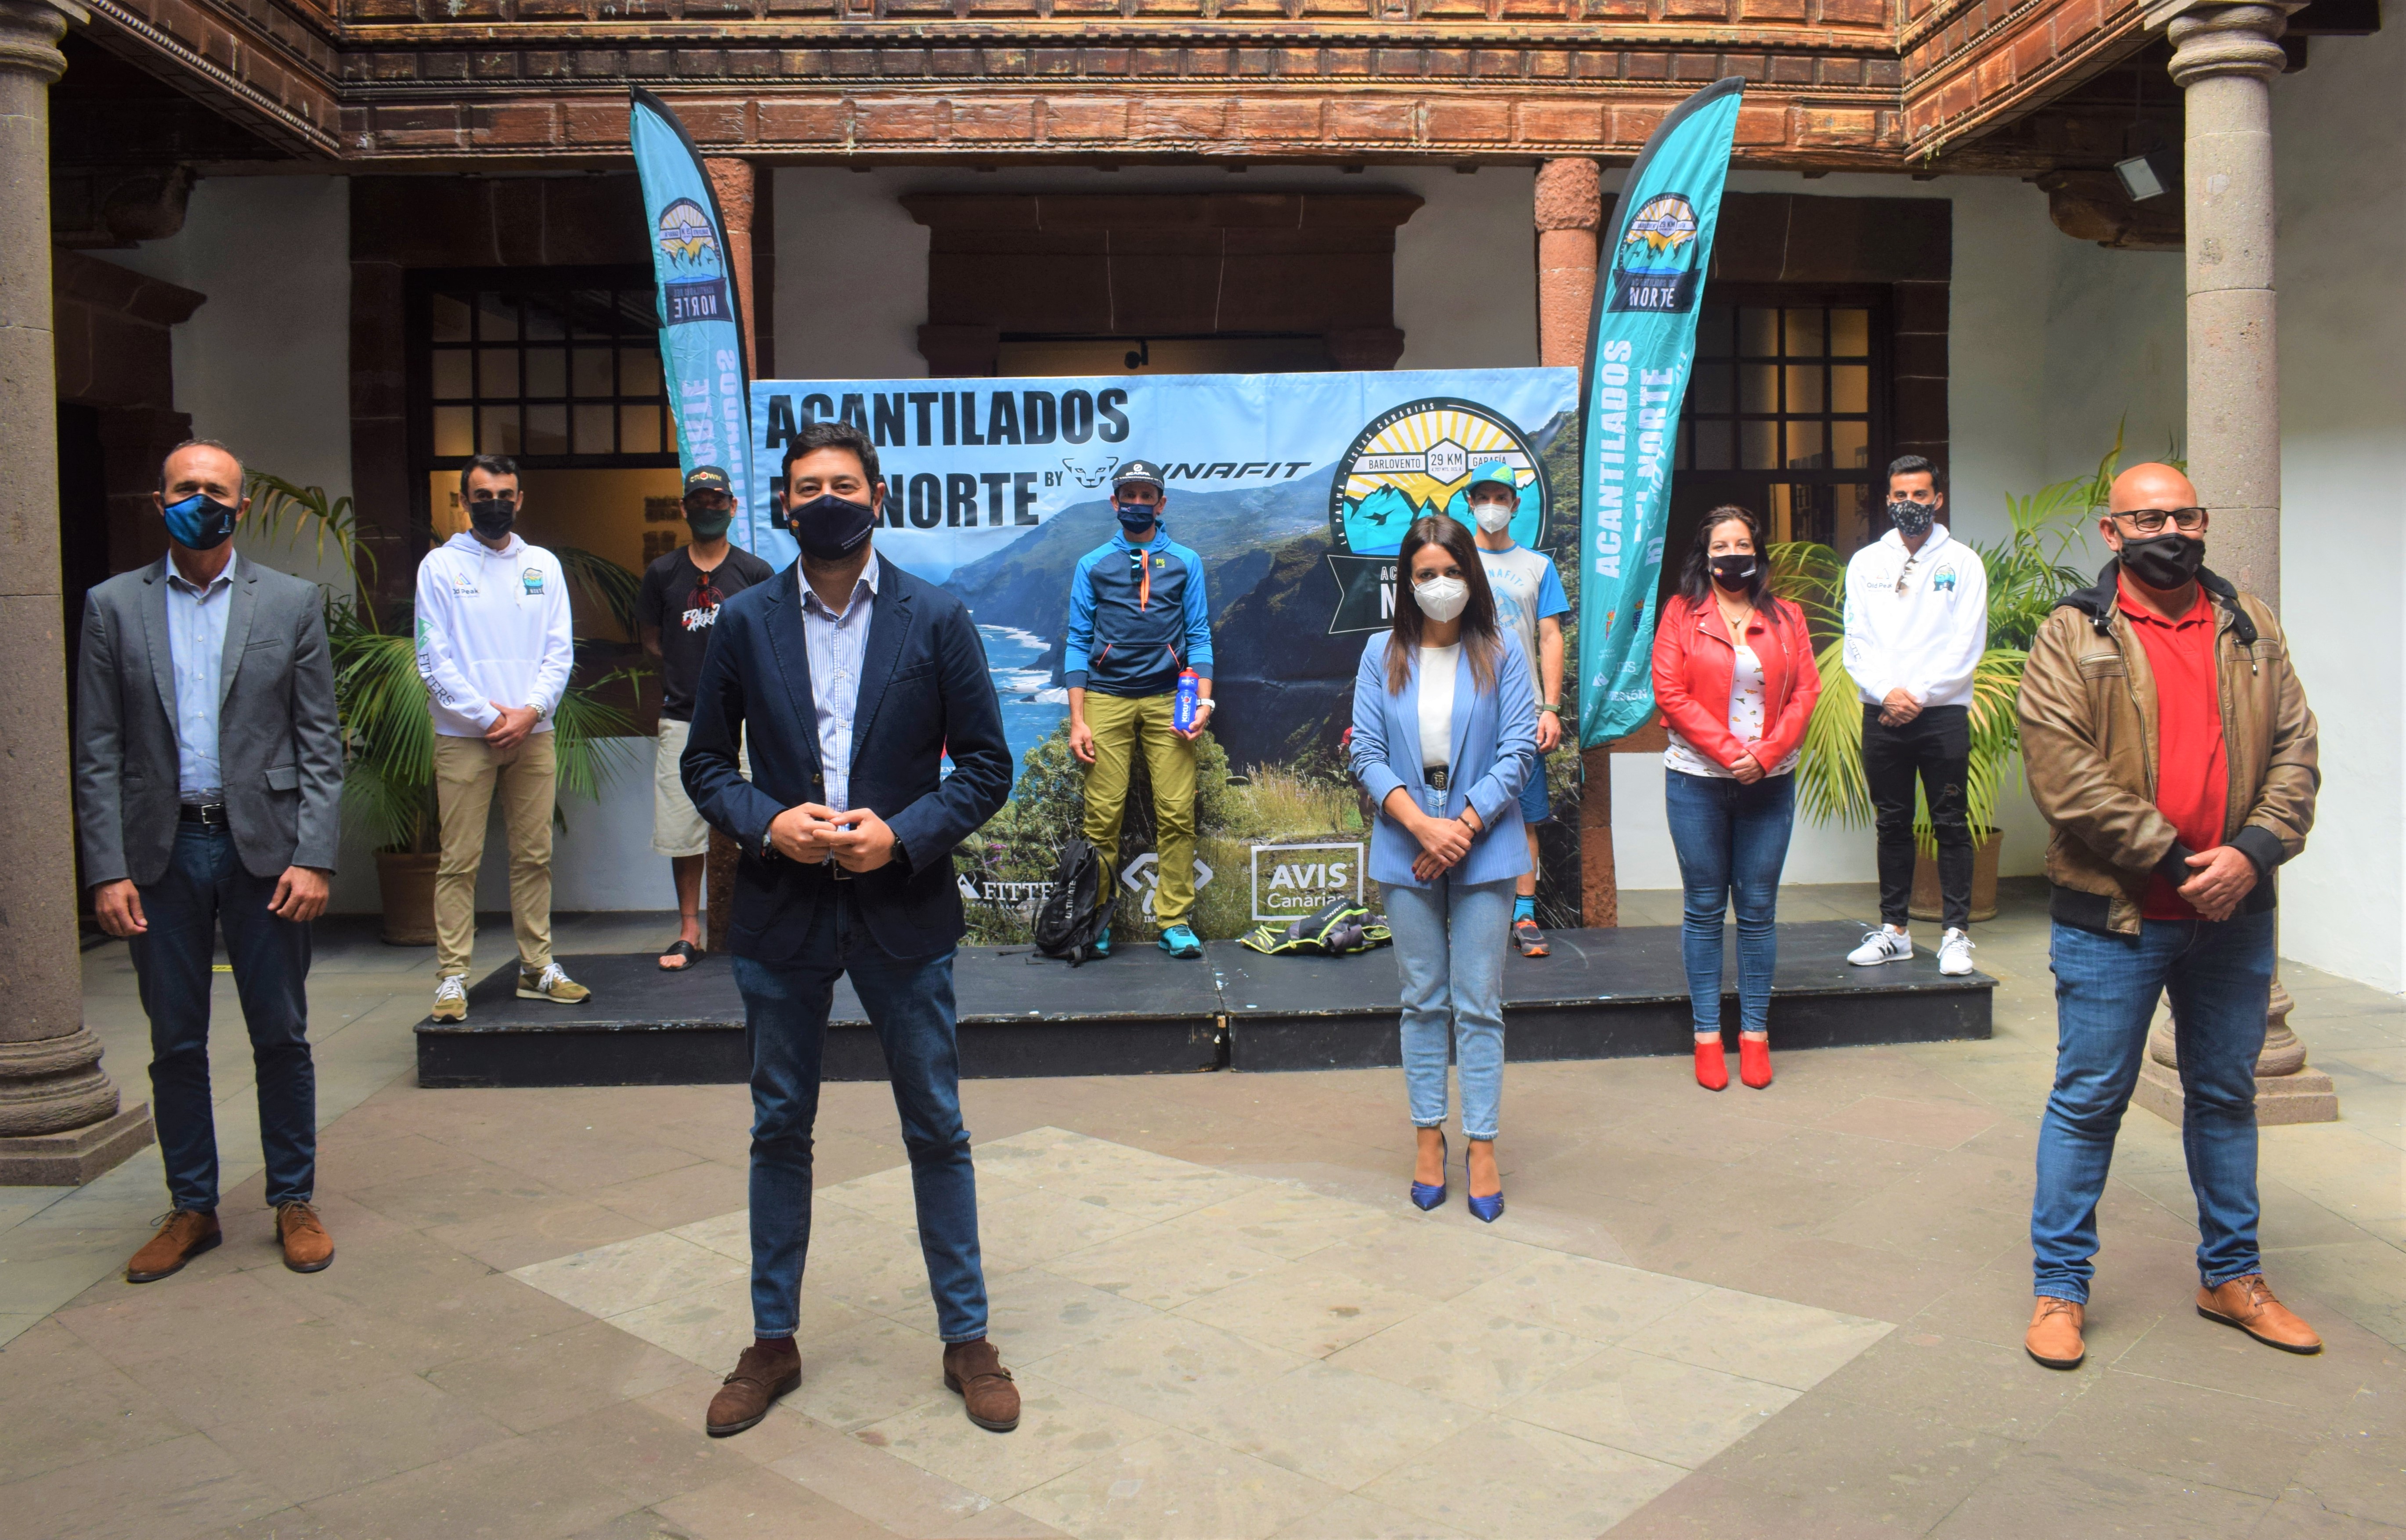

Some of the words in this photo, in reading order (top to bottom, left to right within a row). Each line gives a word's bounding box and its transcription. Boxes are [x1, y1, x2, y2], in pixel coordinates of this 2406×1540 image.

[1629, 287, 1675, 307] NORTE
[1377, 403, 1434, 430] CANARIAS
[1348, 433, 1372, 463] ISLAS
[1431, 454, 1443, 465] 29
[1447, 453, 1462, 465] KM
[1595, 340, 1632, 579] ACANTILADOS
[689, 471, 722, 483] CROWN
[1369, 458, 1420, 469] BARLOVENTO
[880, 472, 1040, 529] NORTE
[1045, 471, 1063, 487] BY
[1336, 485, 1345, 523] PALMA
[1338, 532, 1347, 545] LA
[419, 652, 455, 706] FITTERS
[1268, 862, 1348, 890] AVIS
[1065, 880, 1077, 919] ULTIMATE
